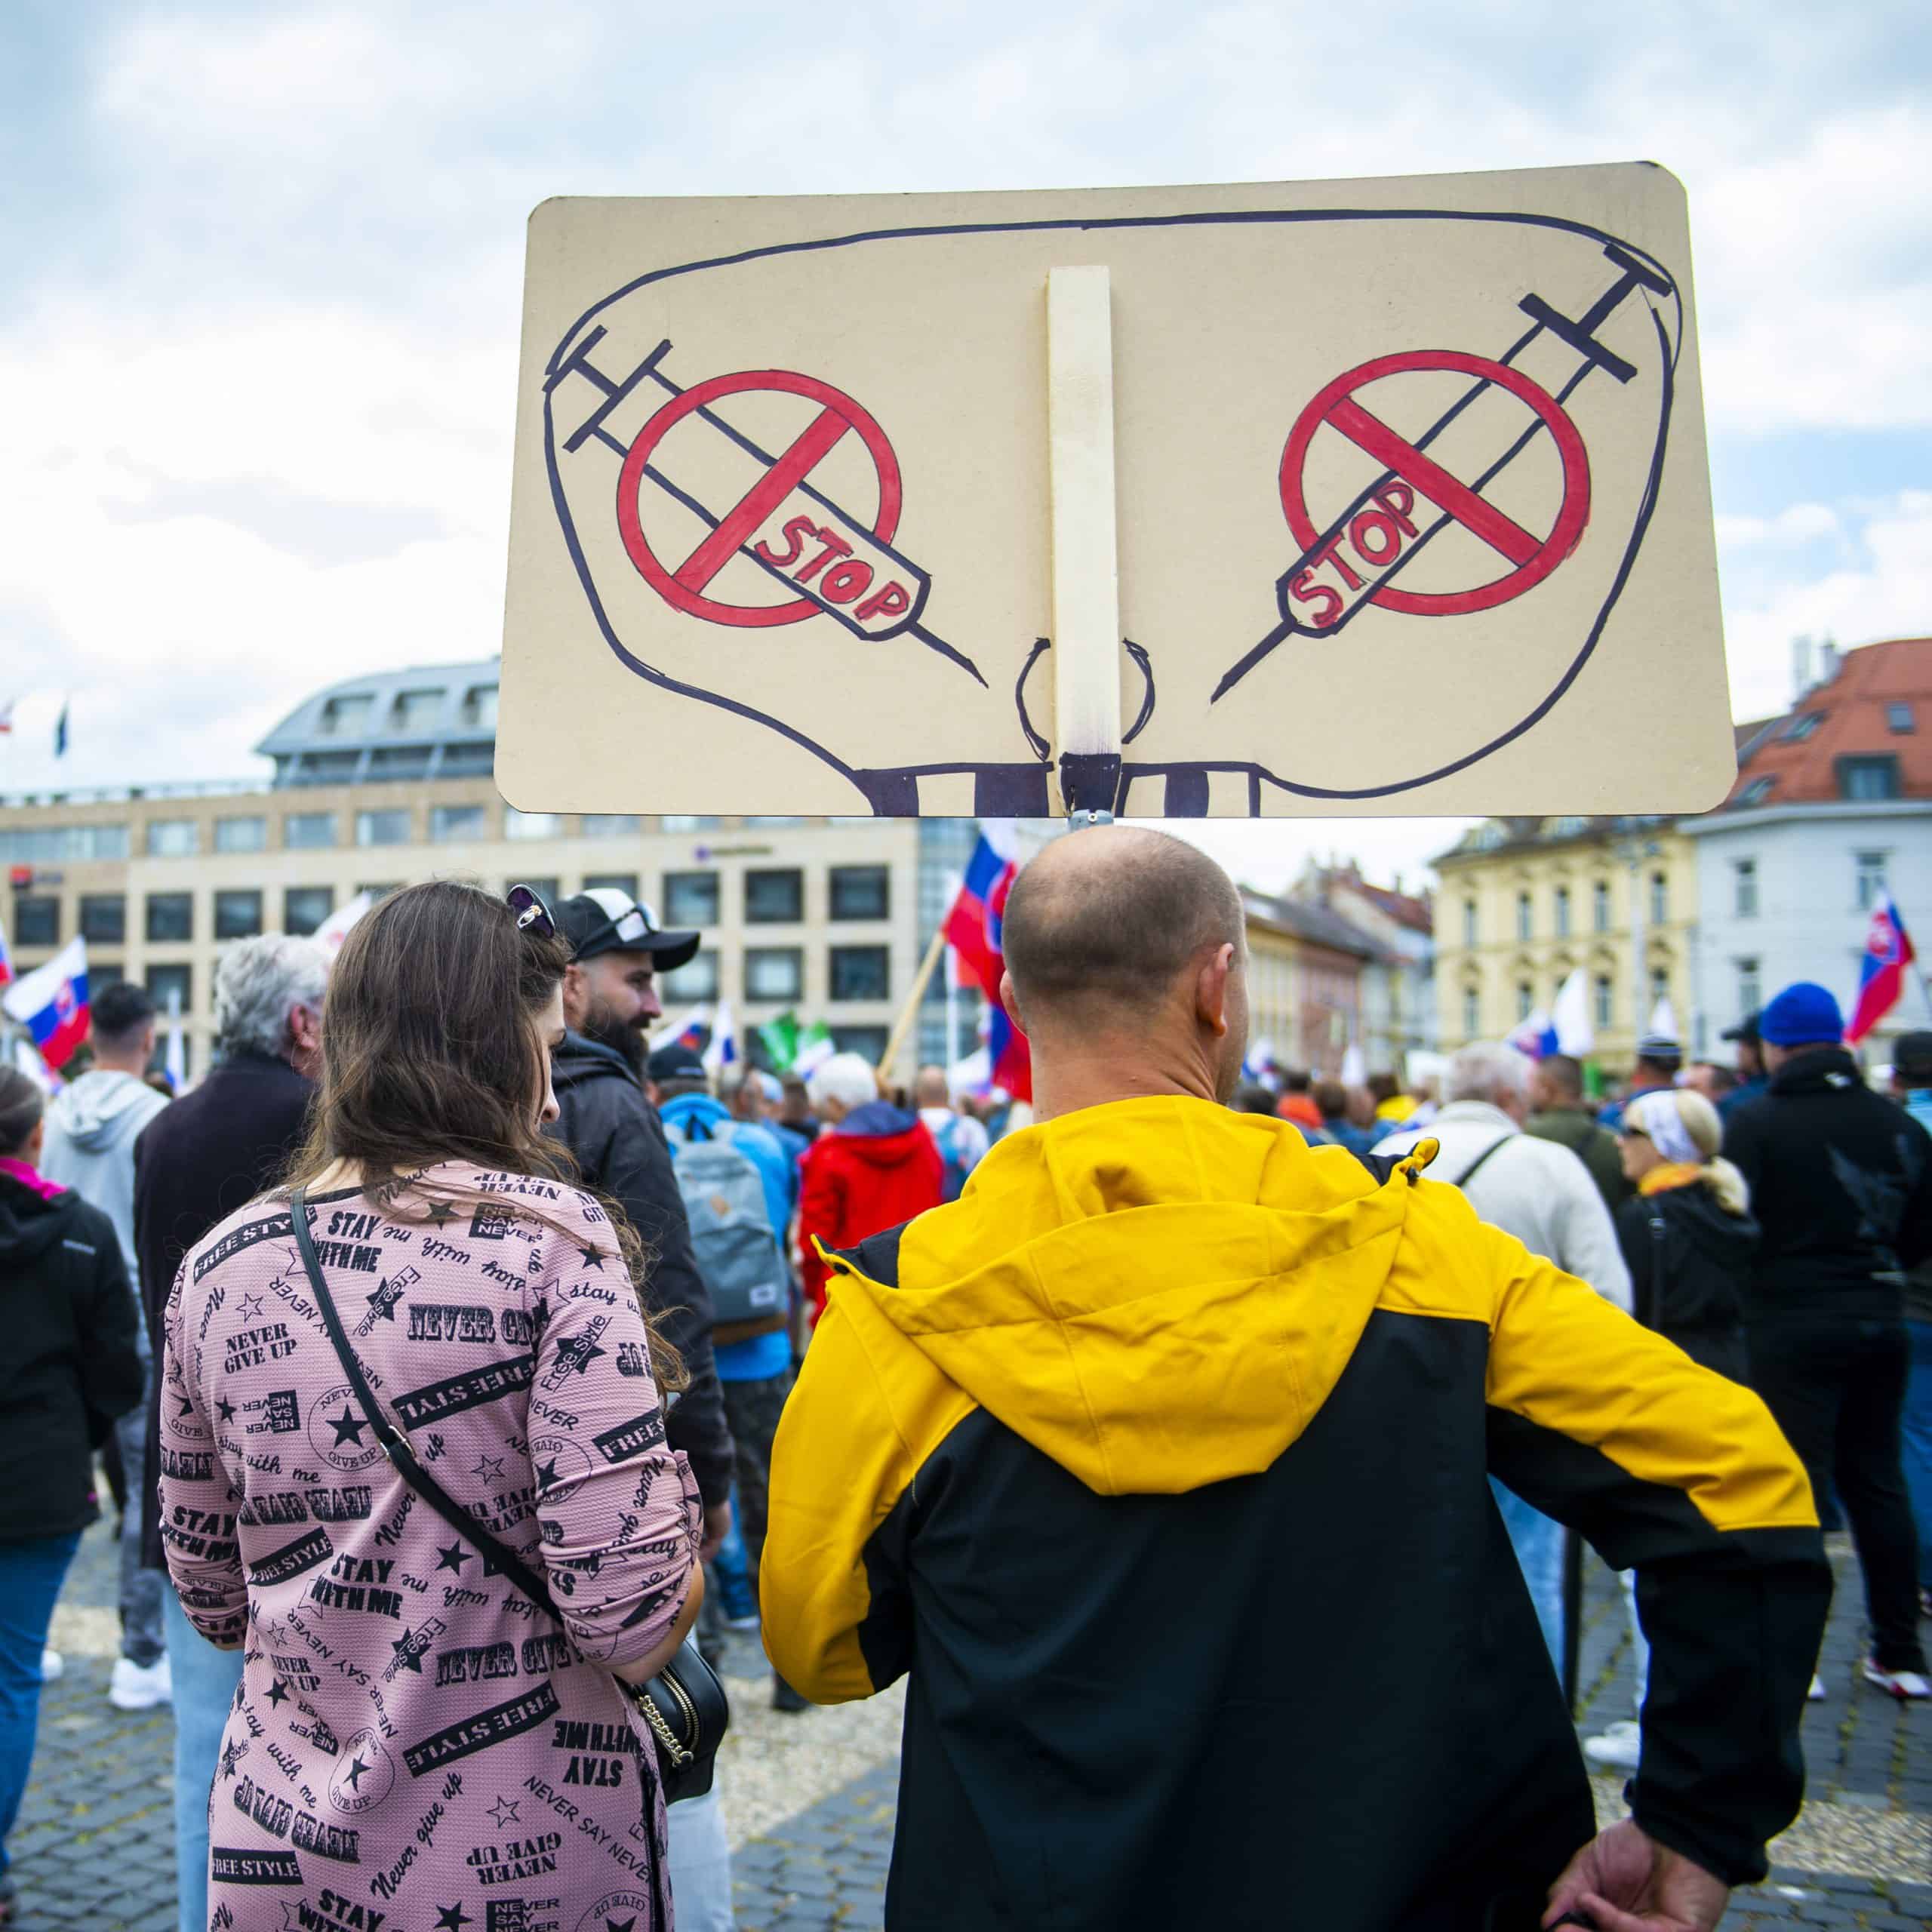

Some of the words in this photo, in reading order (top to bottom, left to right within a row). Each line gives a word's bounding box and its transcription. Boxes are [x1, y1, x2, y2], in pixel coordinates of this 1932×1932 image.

[754, 515, 911, 622] STOP
[1289, 481, 1420, 628] STOP
[328, 1211, 380, 1240] STAY
[383, 1226, 412, 1243] me
[481, 1216, 519, 1226] SAY
[194, 1235, 238, 1278] FREE
[241, 1204, 316, 1242] STYE
[421, 1238, 471, 1265] with
[269, 1276, 318, 1321] NEVER
[569, 1281, 618, 1306] stay
[226, 1323, 290, 1355] NEVER
[408, 1303, 497, 1343] NEVER
[224, 1347, 266, 1374] GIVE
[270, 1339, 297, 1359] UP
[540, 1352, 578, 1392] Free
[242, 1395, 292, 1412] NEVER
[262, 1407, 294, 1420] SAY
[320, 1388, 357, 1411] NEV
[528, 1395, 580, 1431] NEVER
[171, 1419, 204, 1437] GIVE
[246, 1419, 295, 1435] NEVER
[328, 1451, 358, 1468] GIVE
[360, 1447, 377, 1464] UP
[292, 1468, 321, 1483] me
[632, 1456, 666, 1509] Never
[304, 1485, 372, 1523] NEVER
[374, 1492, 417, 1546] Never
[173, 1506, 237, 1537] STAY
[281, 1535, 332, 1571] STYLE
[331, 1552, 395, 1583] STAY
[401, 1574, 429, 1593] me
[442, 1586, 489, 1607] with
[287, 1607, 334, 1659] NEVER
[331, 1659, 371, 1686] SAY
[370, 1684, 399, 1739] NEVER
[434, 1641, 518, 1687] NEVER
[298, 1674, 321, 1691] UP
[496, 1684, 555, 1731] FREE
[289, 1720, 335, 1752] NEVER
[407, 1721, 491, 1770] STYLE
[266, 1742, 303, 1783] with
[300, 1783, 318, 1810] me
[562, 1756, 624, 1788] STAY
[352, 1795, 372, 1810] UP
[291, 1810, 361, 1864] NEVER
[370, 1845, 418, 1900] Never
[416, 1801, 445, 1847] give
[441, 1772, 463, 1800] up
[523, 1775, 579, 1823] NEVER
[577, 1817, 611, 1846] SAY
[608, 1841, 652, 1884] NEVE
[466, 1845, 506, 1866] UP
[507, 1832, 563, 1861] GIVE
[242, 1860, 303, 1878] STYLE
[476, 1853, 558, 1885] NEVER
[318, 1888, 386, 1932] STAY
[494, 1897, 560, 1914] NEVER
[494, 1912, 534, 1924] SAY
[611, 1894, 645, 1912] GIVE
